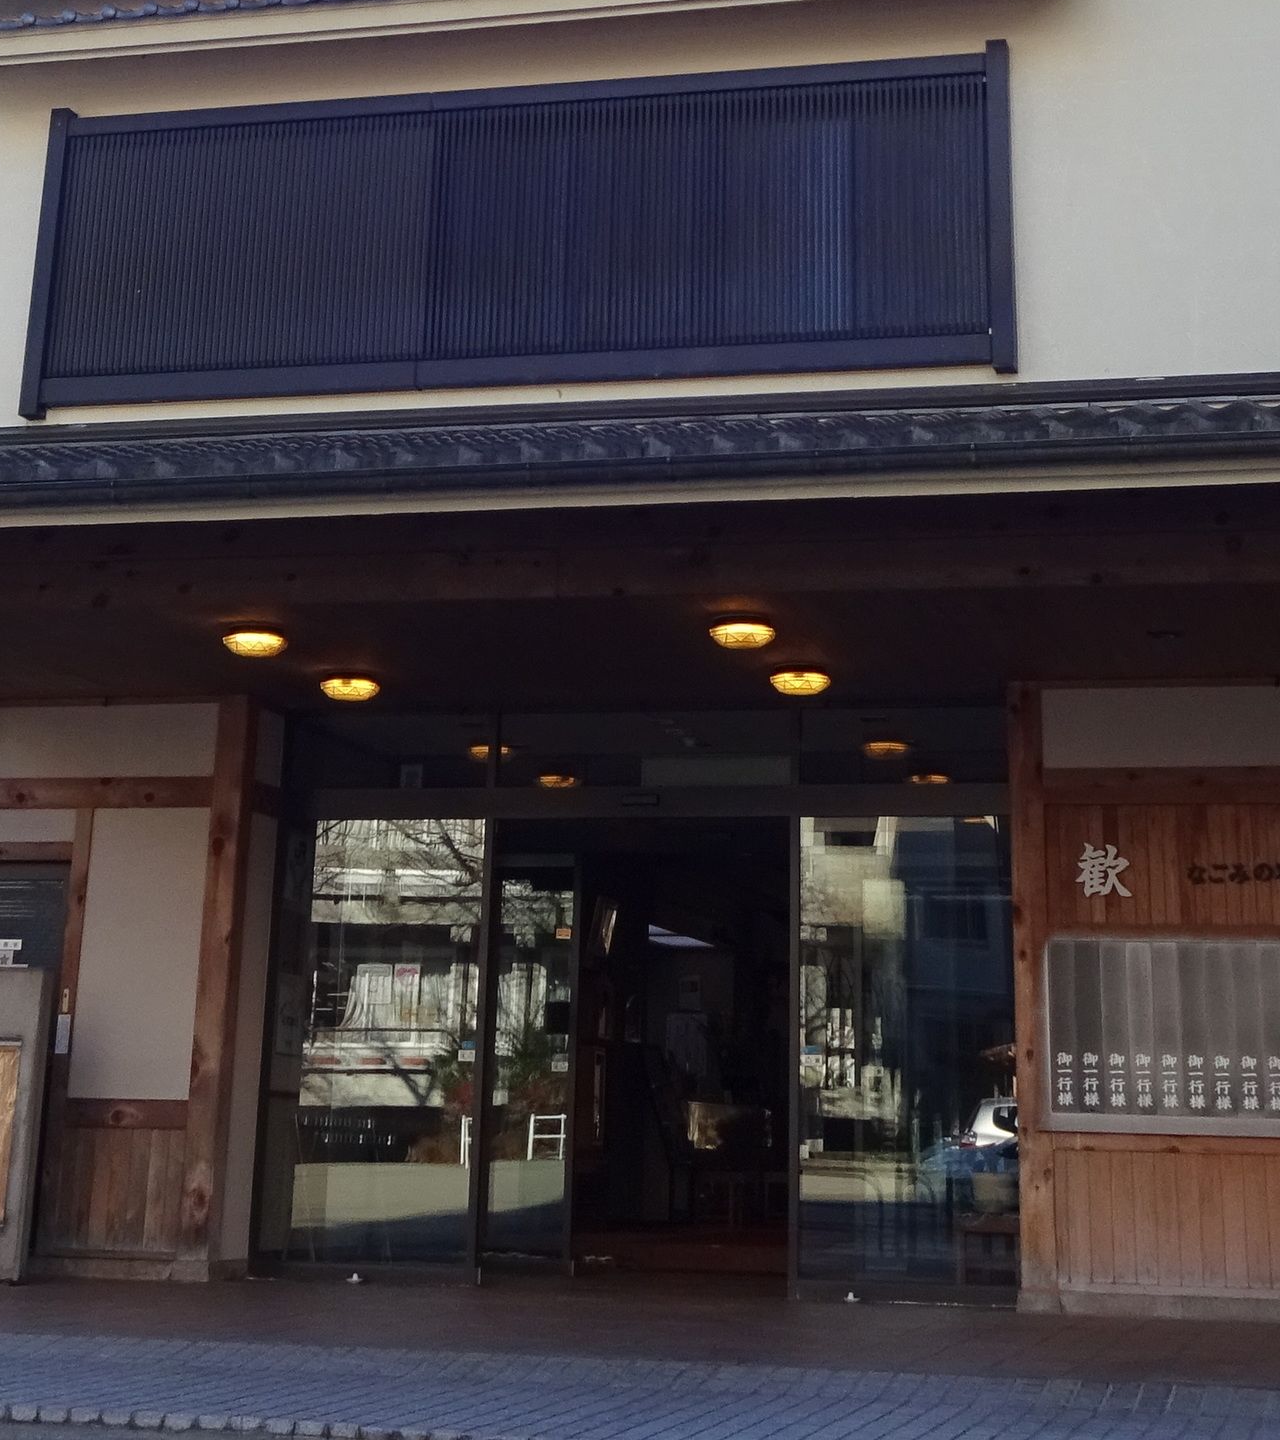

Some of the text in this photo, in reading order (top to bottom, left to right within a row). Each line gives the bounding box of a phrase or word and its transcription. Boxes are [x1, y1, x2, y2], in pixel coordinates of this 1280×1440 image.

[1056, 1052, 1074, 1107] 御一行様
[1083, 1052, 1099, 1106] 御一行様
[1109, 1053, 1125, 1107] 御一行様
[1135, 1054, 1152, 1107] 御一行様
[1162, 1054, 1178, 1108] 御一行様
[1188, 1055, 1205, 1109] 御一行様
[1214, 1056, 1231, 1110] 御一行様
[1241, 1056, 1259, 1110] 御一行様
